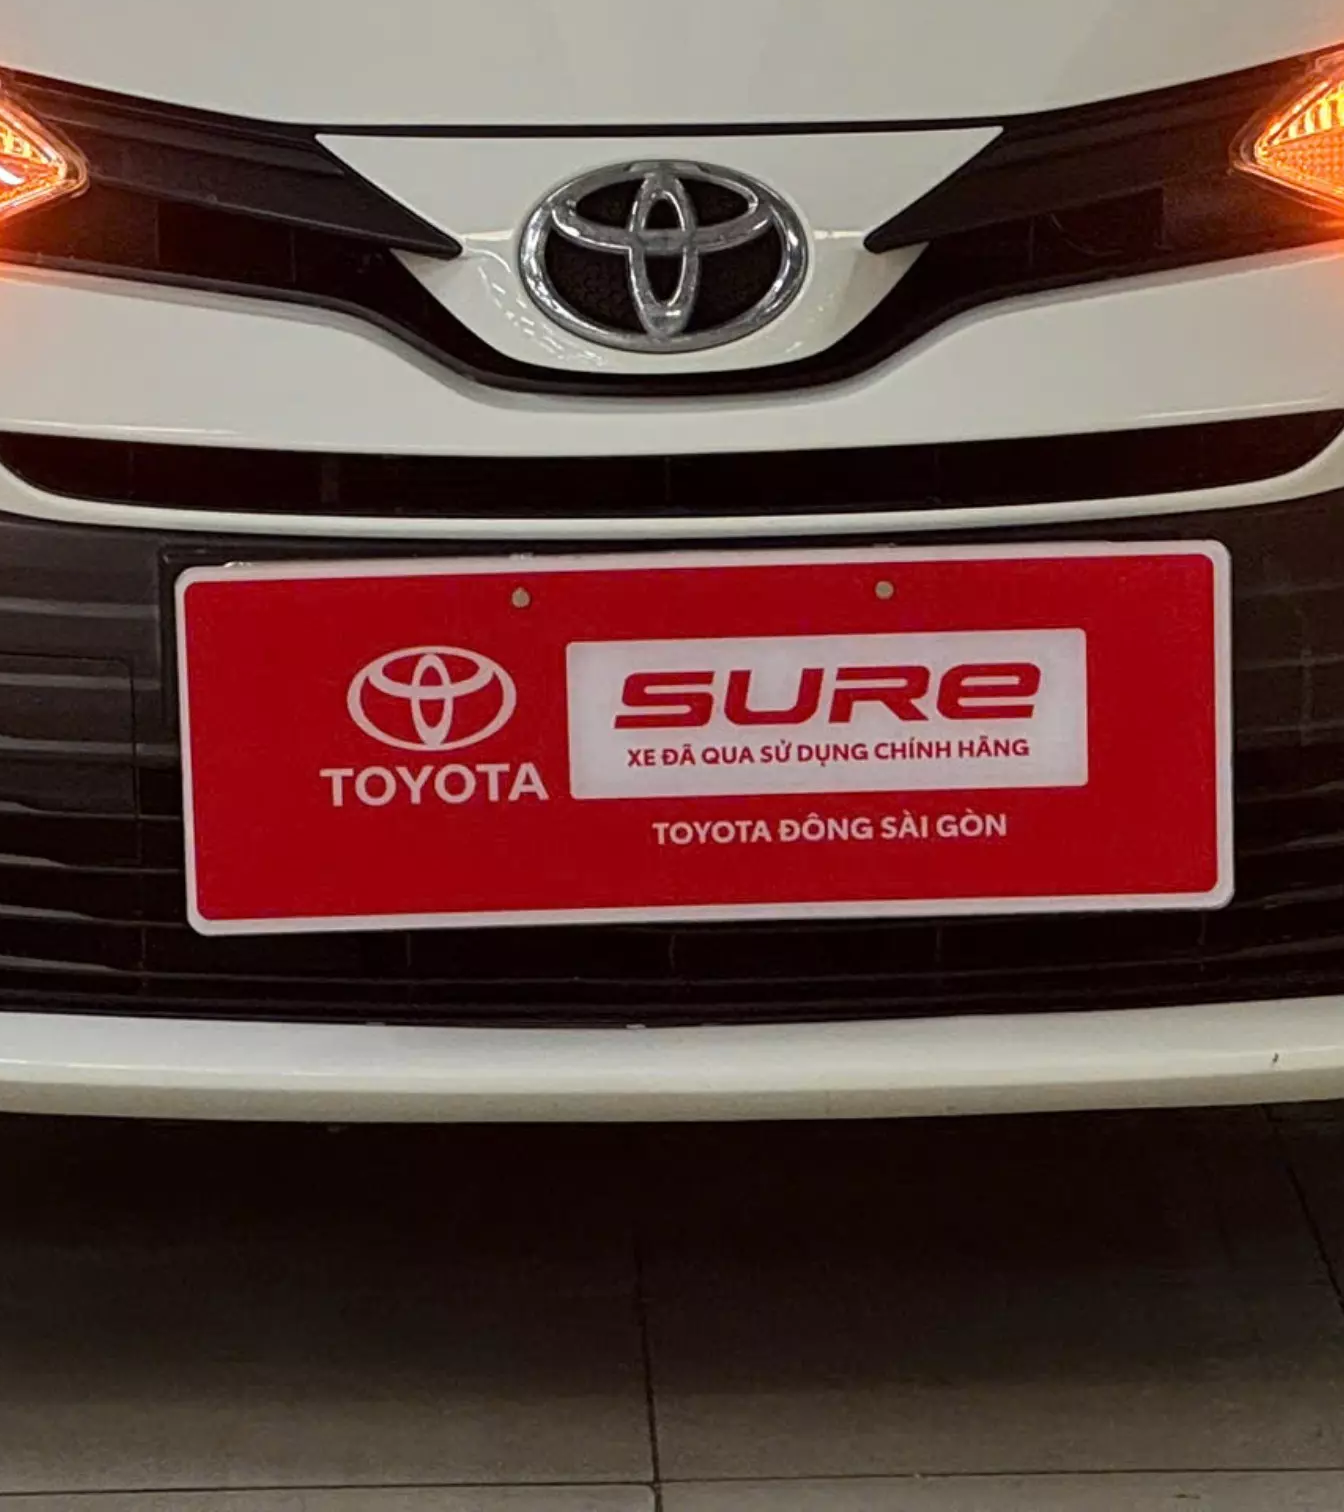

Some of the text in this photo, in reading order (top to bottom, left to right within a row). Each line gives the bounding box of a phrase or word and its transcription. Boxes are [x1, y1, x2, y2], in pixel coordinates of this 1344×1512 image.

[626, 735, 1031, 768] XE ĐÃ QUA SỬ DỤNG CHÍNH HÃNG
[320, 761, 549, 807] TOYOTA
[652, 810, 1008, 847] TOYOTA ĐÔNG SÀI GÒN
